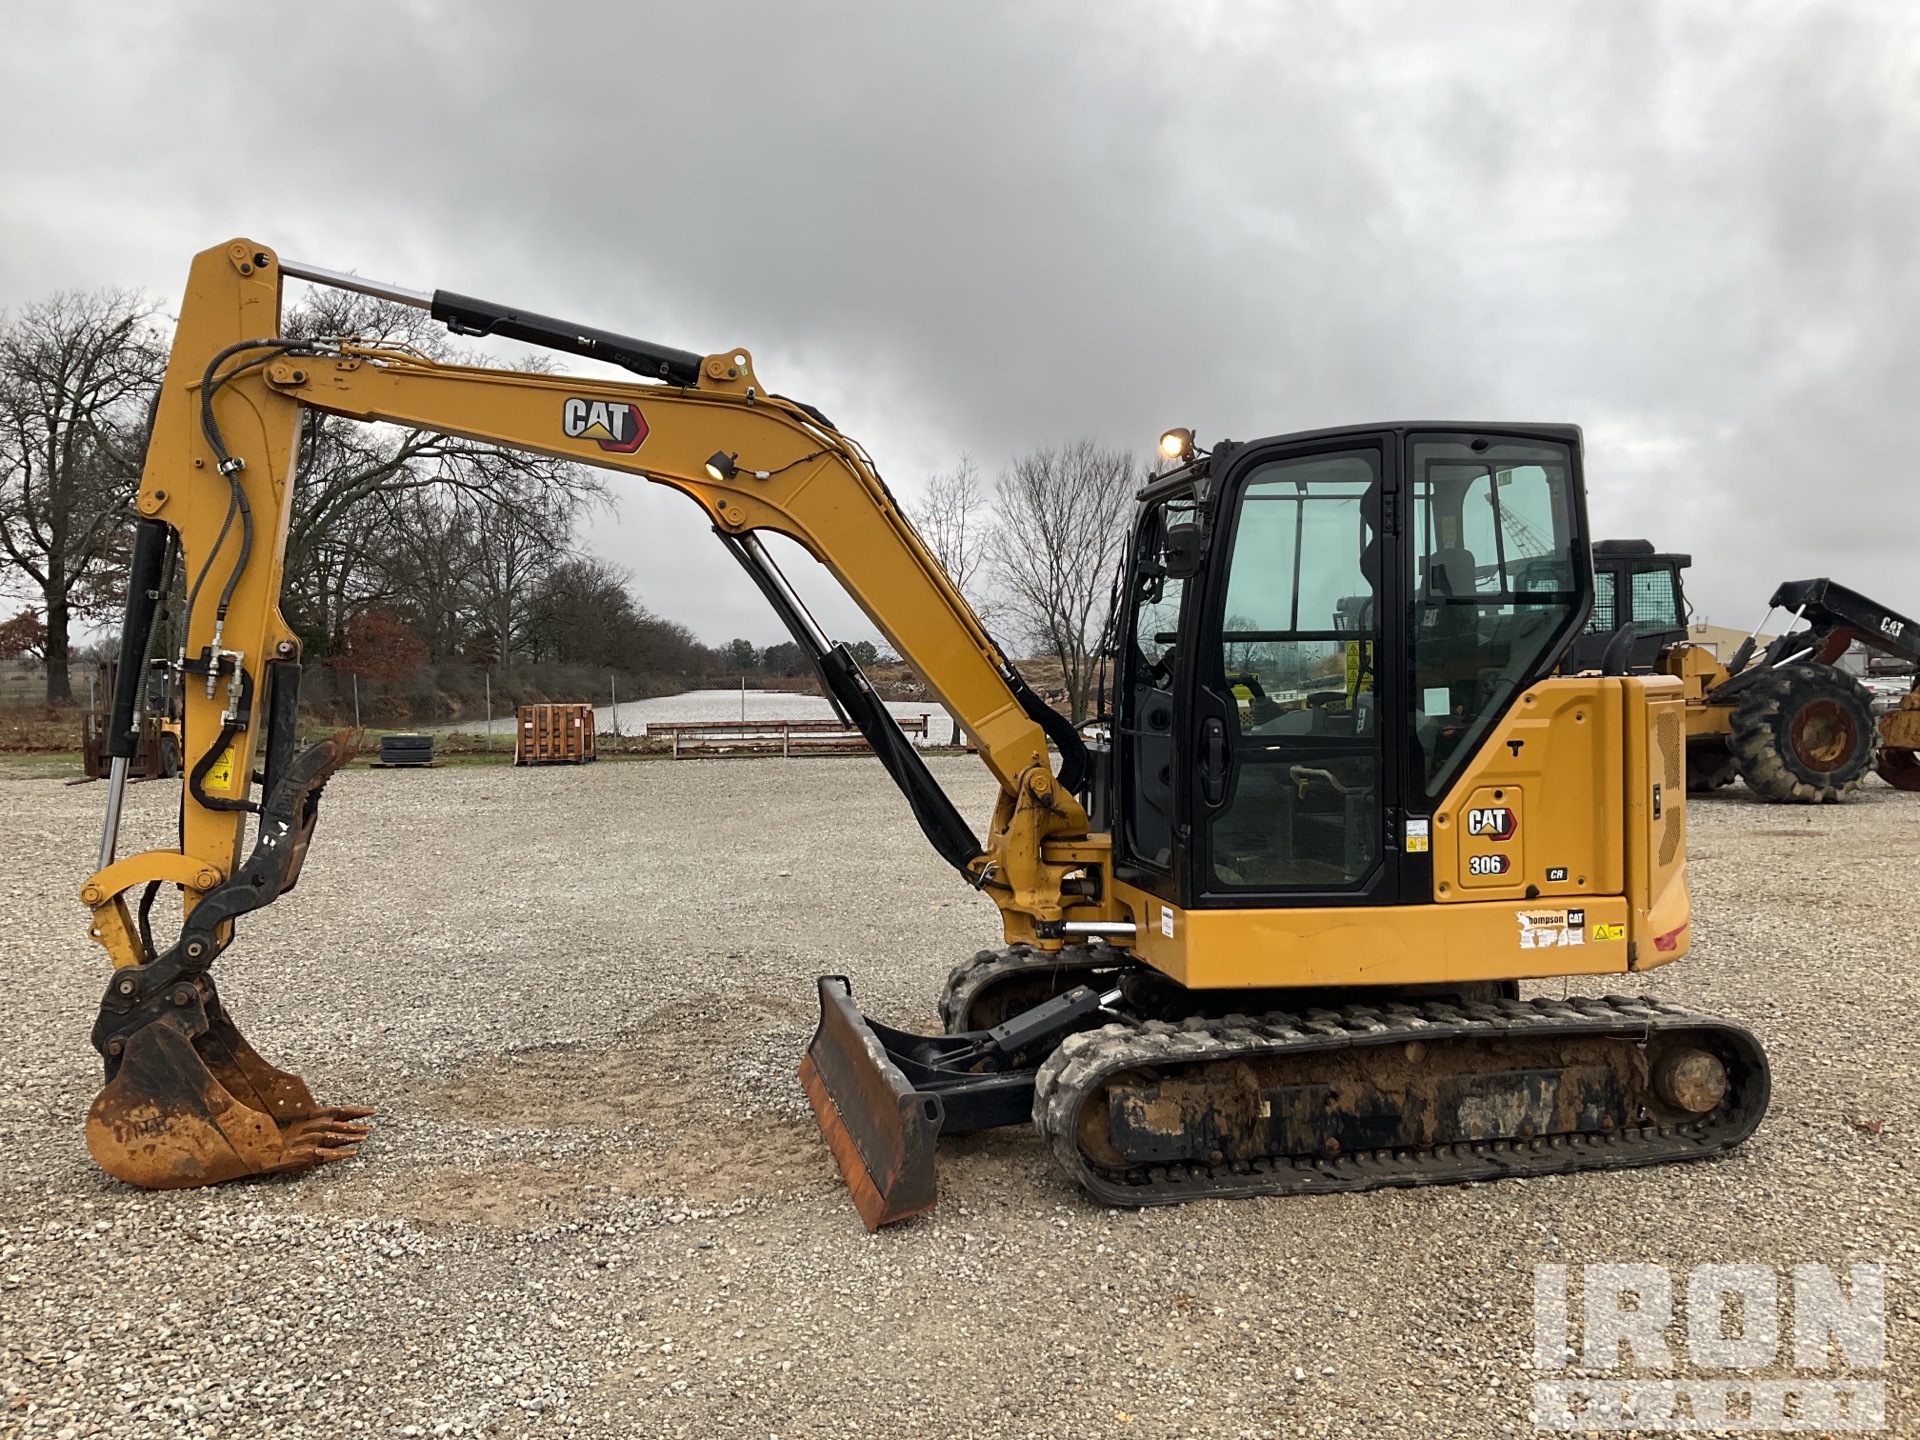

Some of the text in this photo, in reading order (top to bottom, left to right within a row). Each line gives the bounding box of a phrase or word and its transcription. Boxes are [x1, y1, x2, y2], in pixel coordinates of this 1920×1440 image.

[564, 398, 629, 441] CAT
[1880, 616, 1905, 638] CAT
[1468, 808, 1506, 835] CAT
[1469, 855, 1501, 875] 306
[1550, 869, 1564, 879] CR
[1568, 912, 1583, 924] CAT
